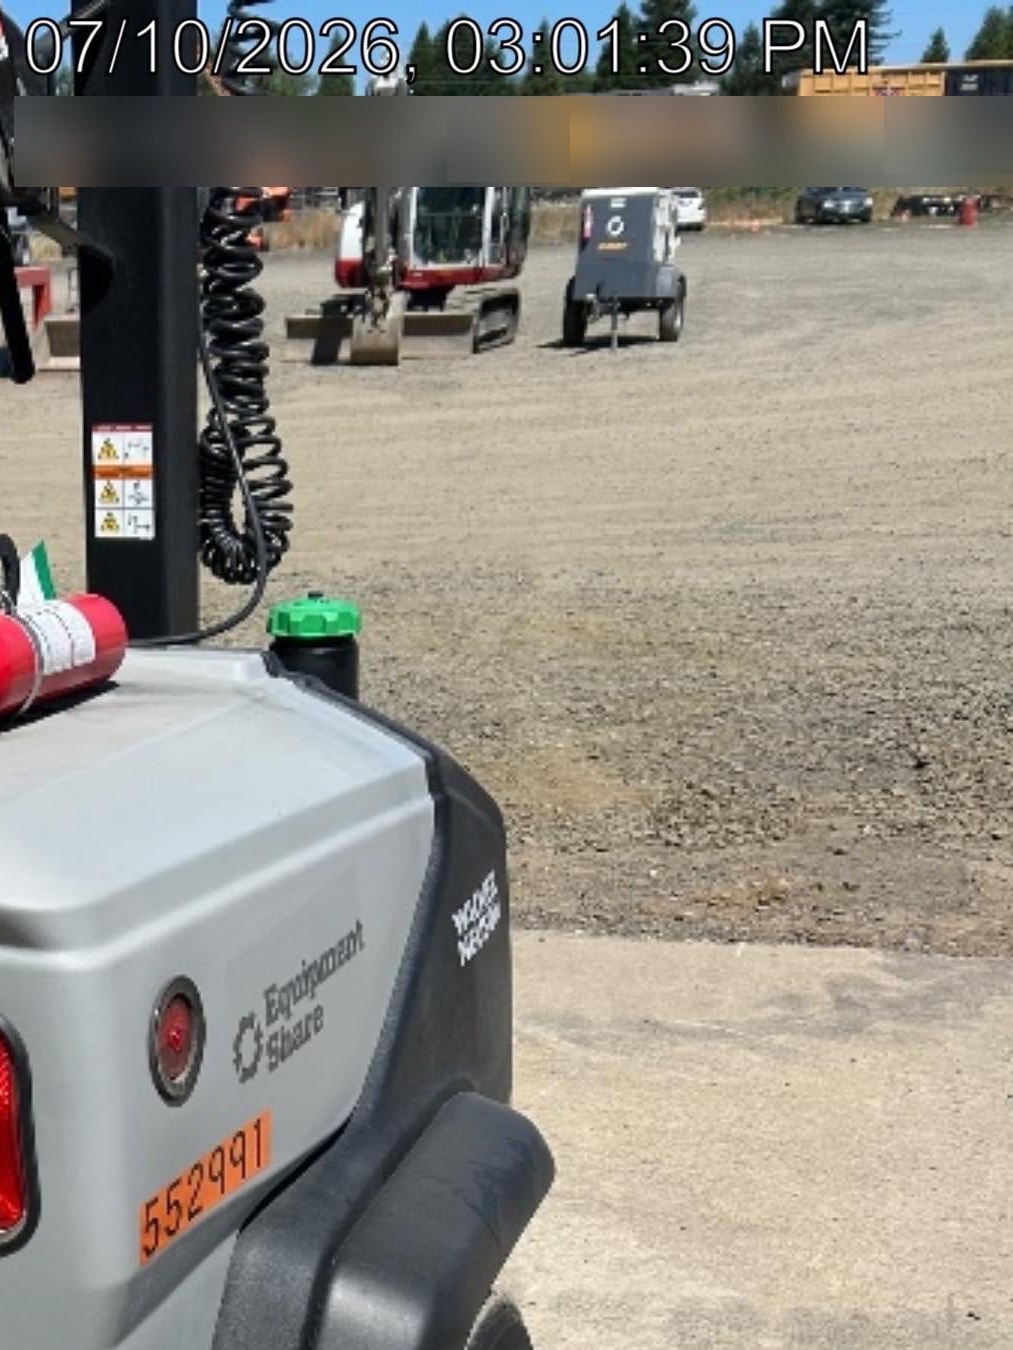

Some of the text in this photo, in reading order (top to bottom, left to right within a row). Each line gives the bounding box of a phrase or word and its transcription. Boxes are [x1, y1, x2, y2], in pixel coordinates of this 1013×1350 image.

[263, 918, 366, 1027] Equipment
[266, 1004, 324, 1073] Share
[142, 1118, 261, 1257] 552991
